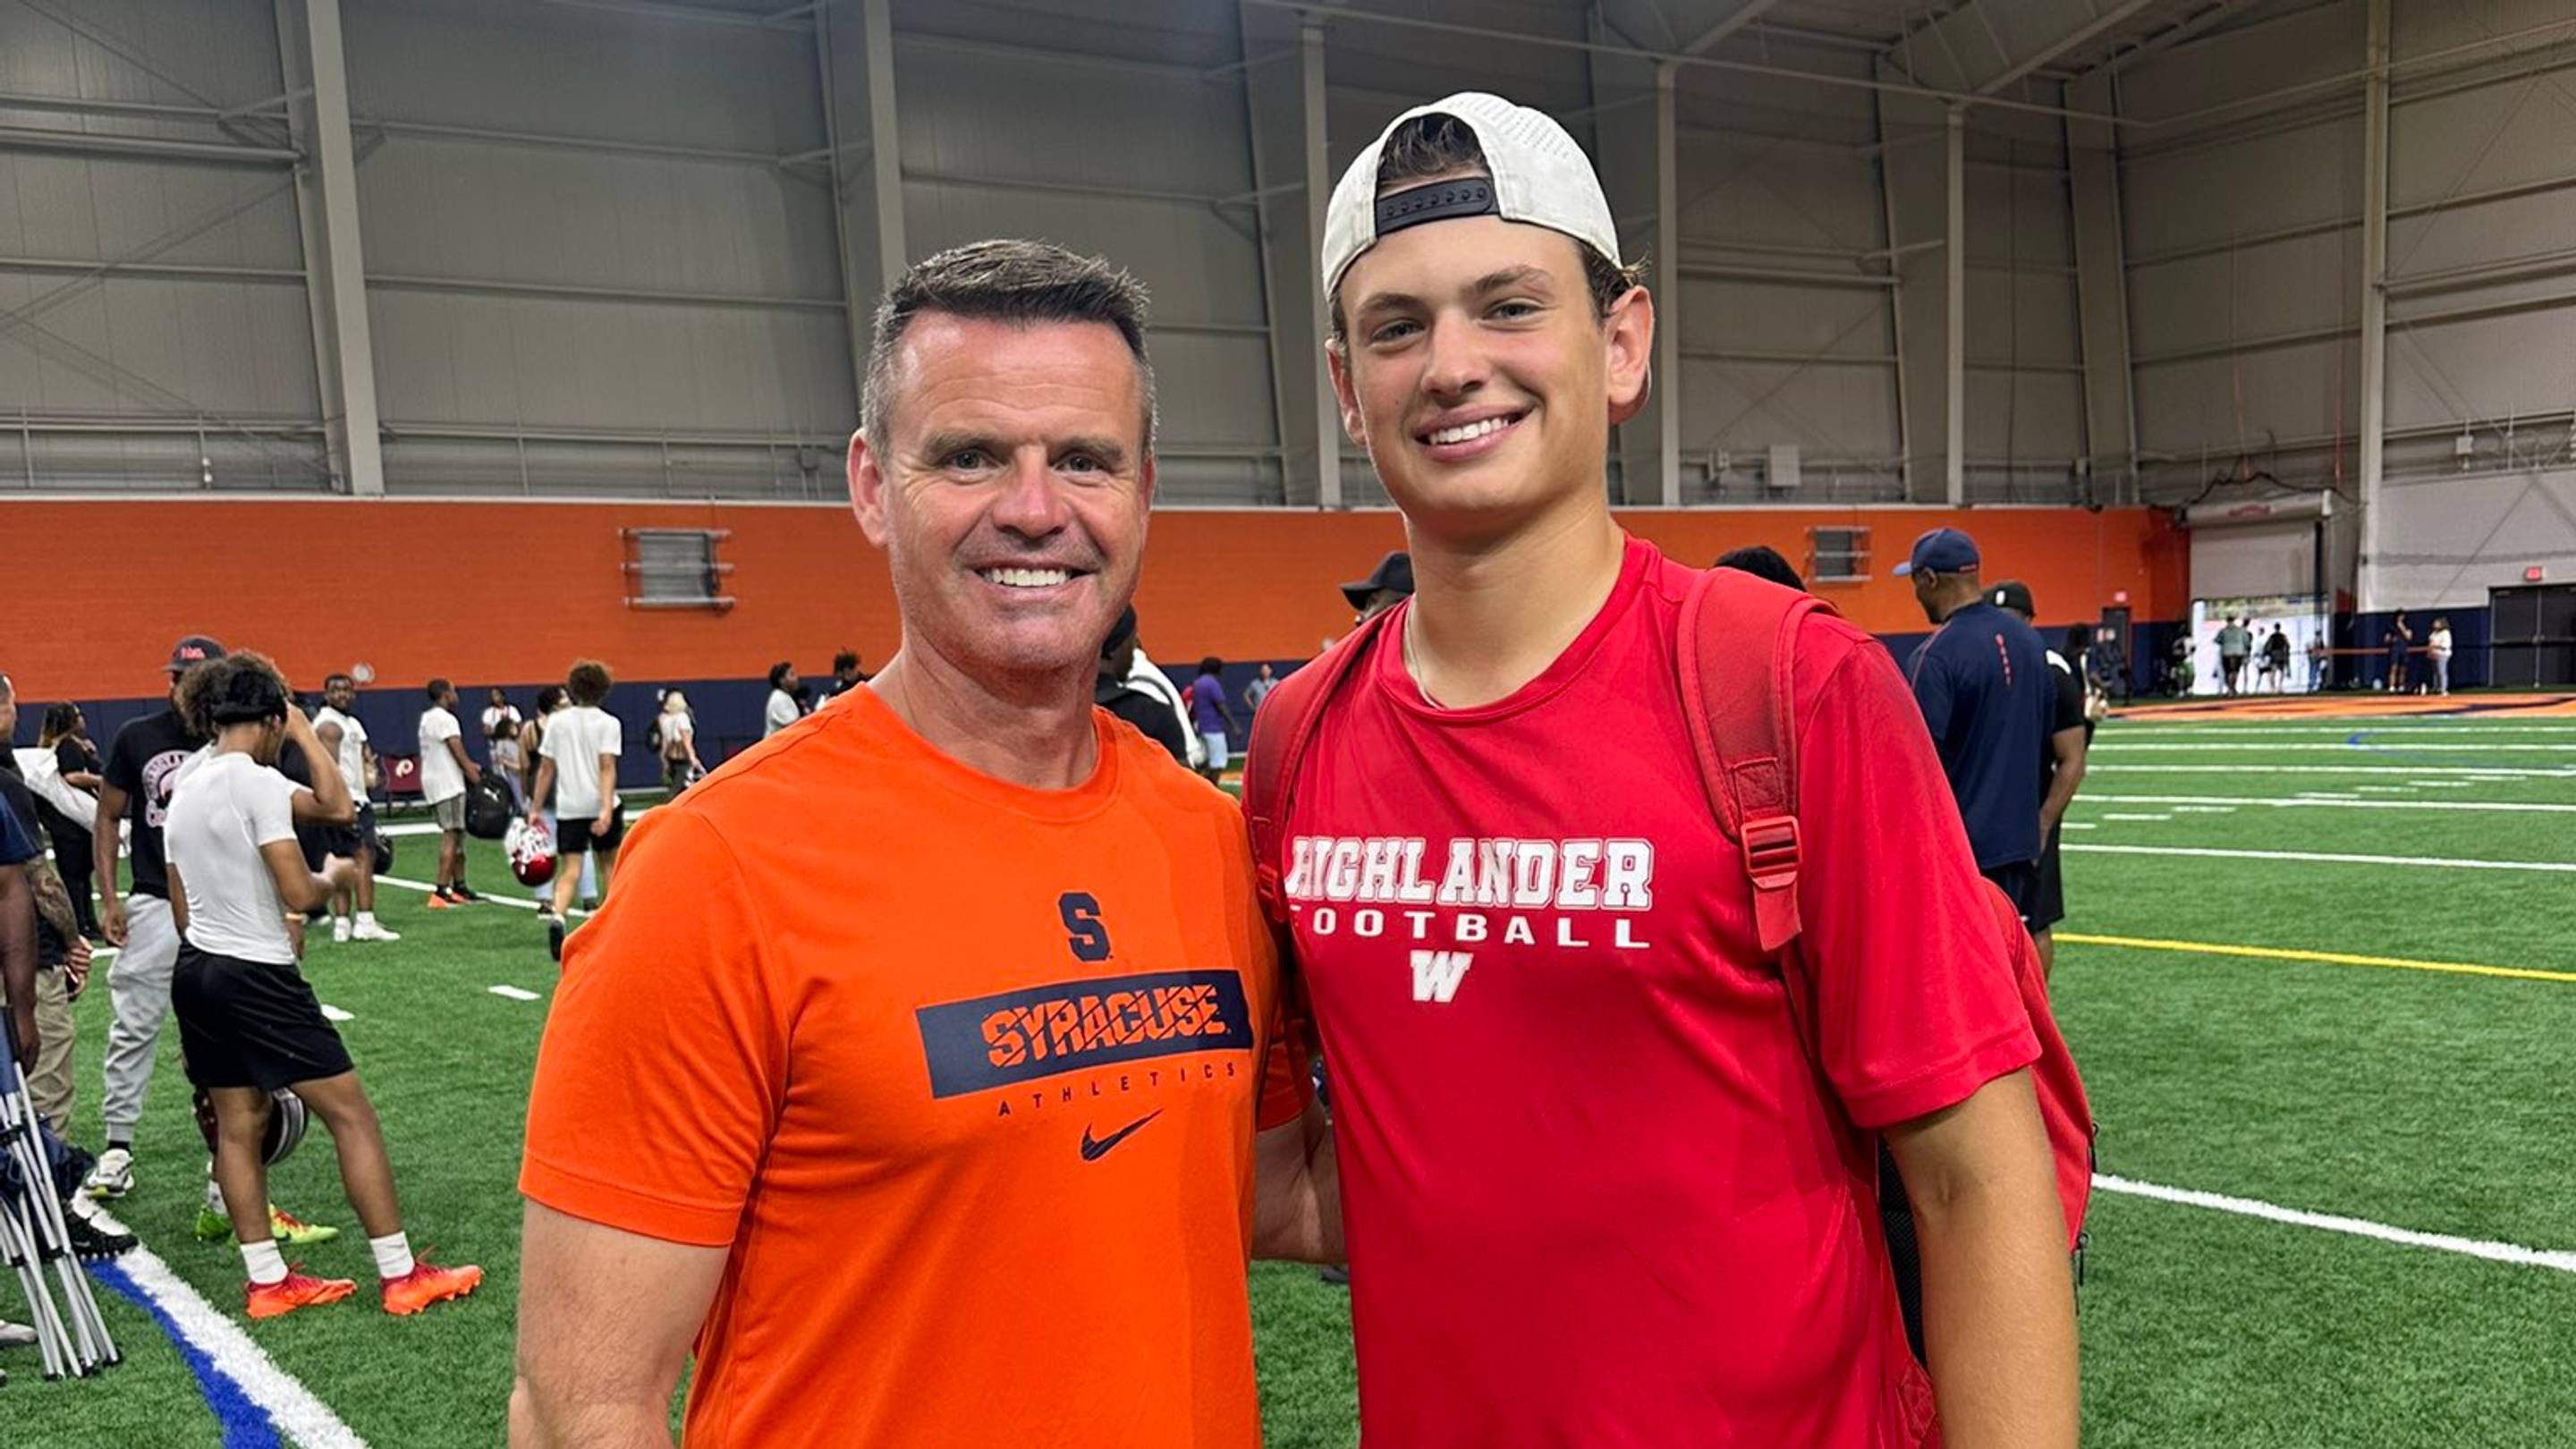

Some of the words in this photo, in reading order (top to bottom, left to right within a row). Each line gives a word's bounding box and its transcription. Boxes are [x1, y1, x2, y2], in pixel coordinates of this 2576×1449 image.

[1284, 836, 1653, 910] HIGHLANDER
[1058, 892, 1112, 962] S
[1410, 949, 1474, 1003] W
[981, 984, 1227, 1068] SYRACUSE
[997, 1062, 1235, 1116] ATHLETICS
